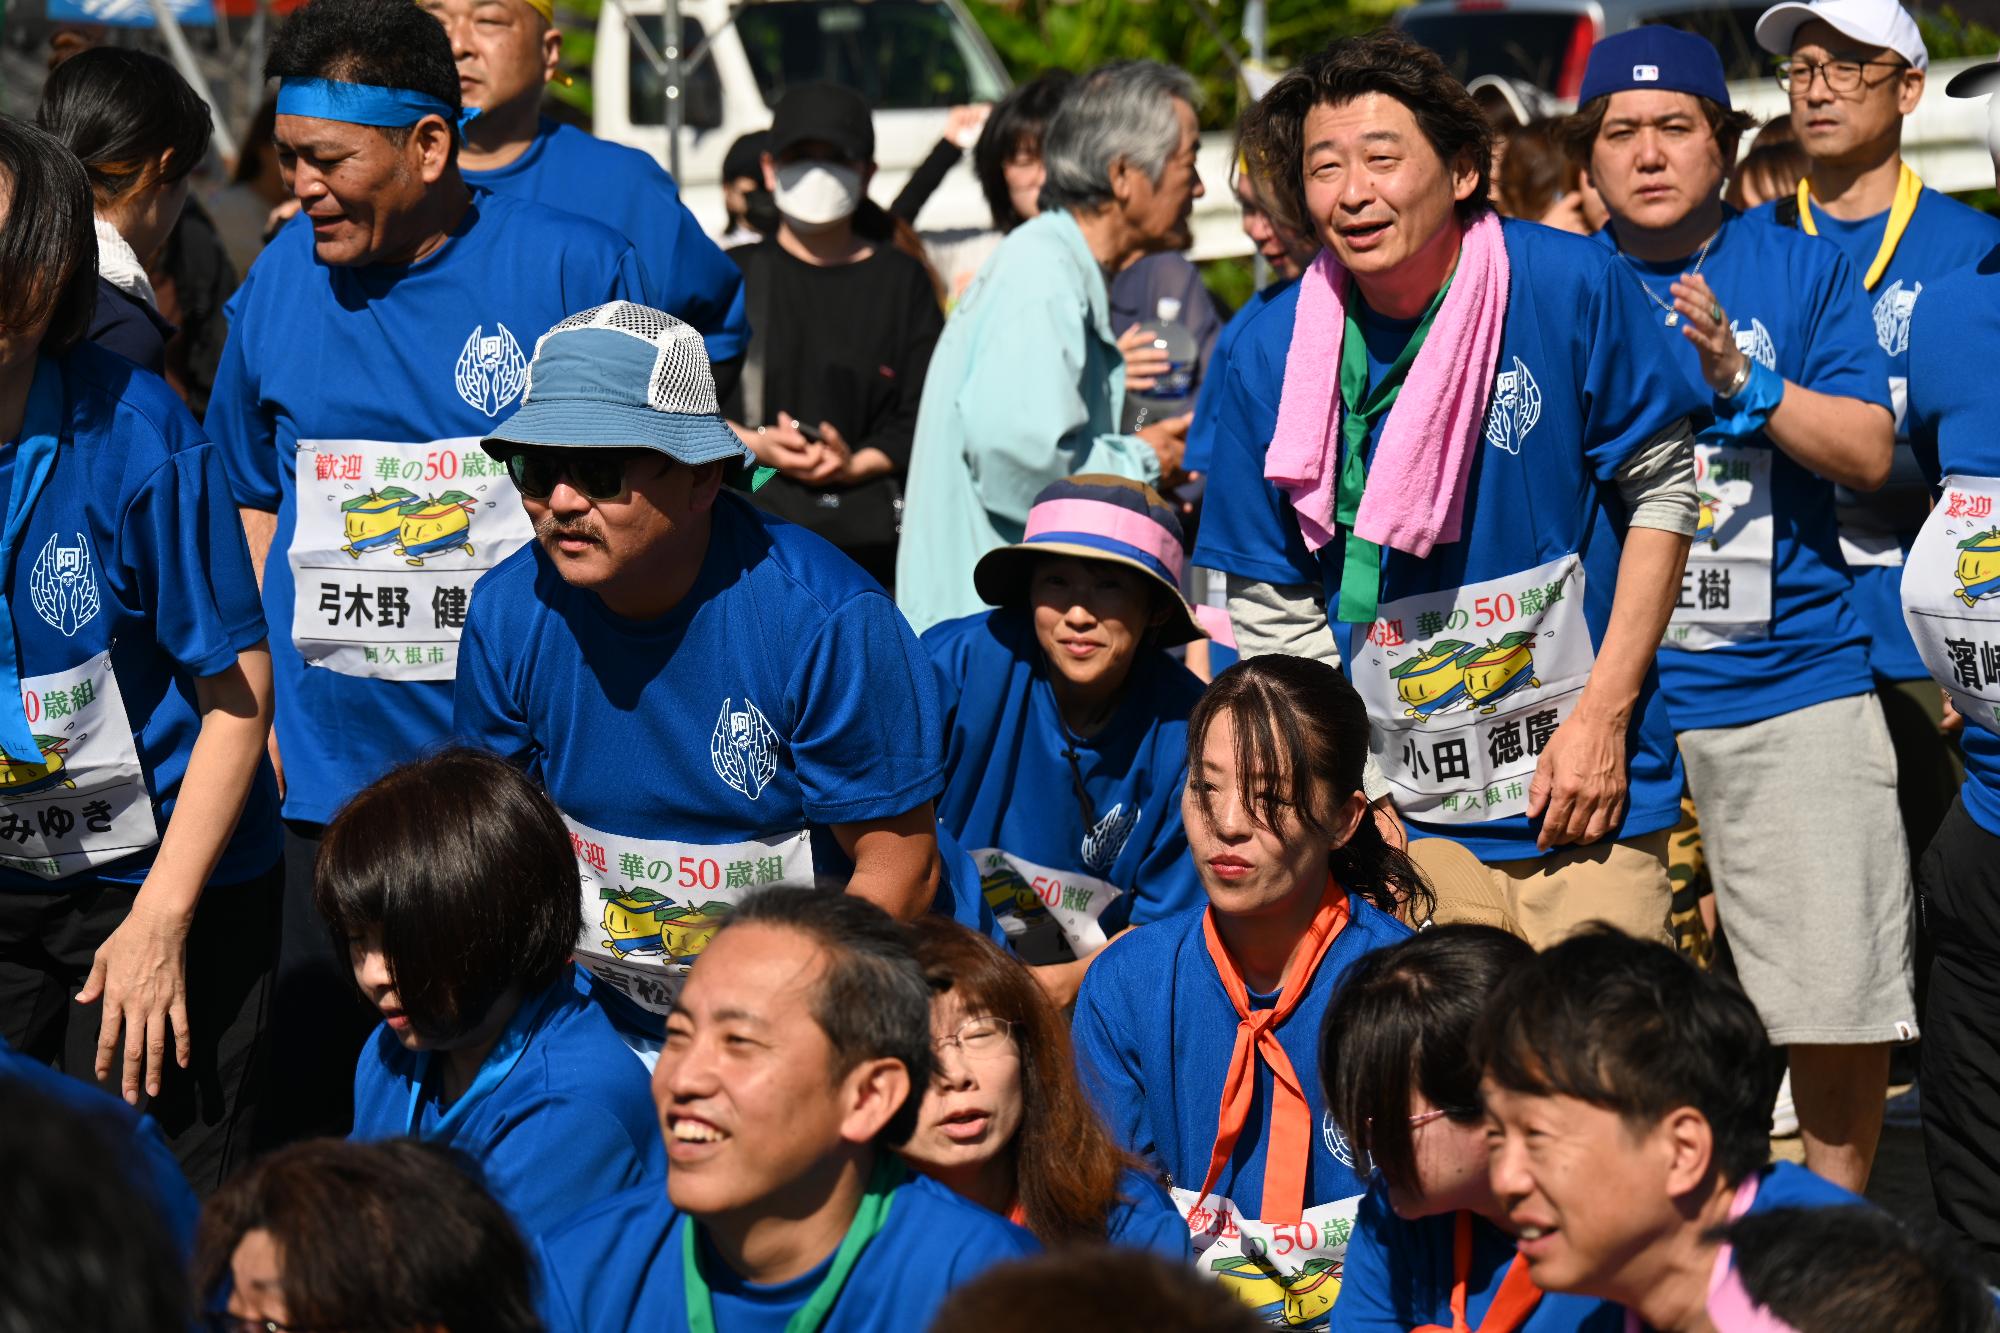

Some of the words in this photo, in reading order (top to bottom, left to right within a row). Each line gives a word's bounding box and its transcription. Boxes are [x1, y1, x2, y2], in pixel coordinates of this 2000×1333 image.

[315, 453, 363, 481] 歓迎
[319, 582, 411, 629] 弓木野
[1415, 579, 1566, 641] 華の50歳組
[364, 646, 444, 665] 阿久根市
[22, 678, 97, 723] 0歳組
[1403, 738, 1471, 784] 小田
[1441, 781, 1524, 813] 阿久根市
[0, 799, 113, 845] みゆき
[618, 852, 785, 890] 華の50歳組
